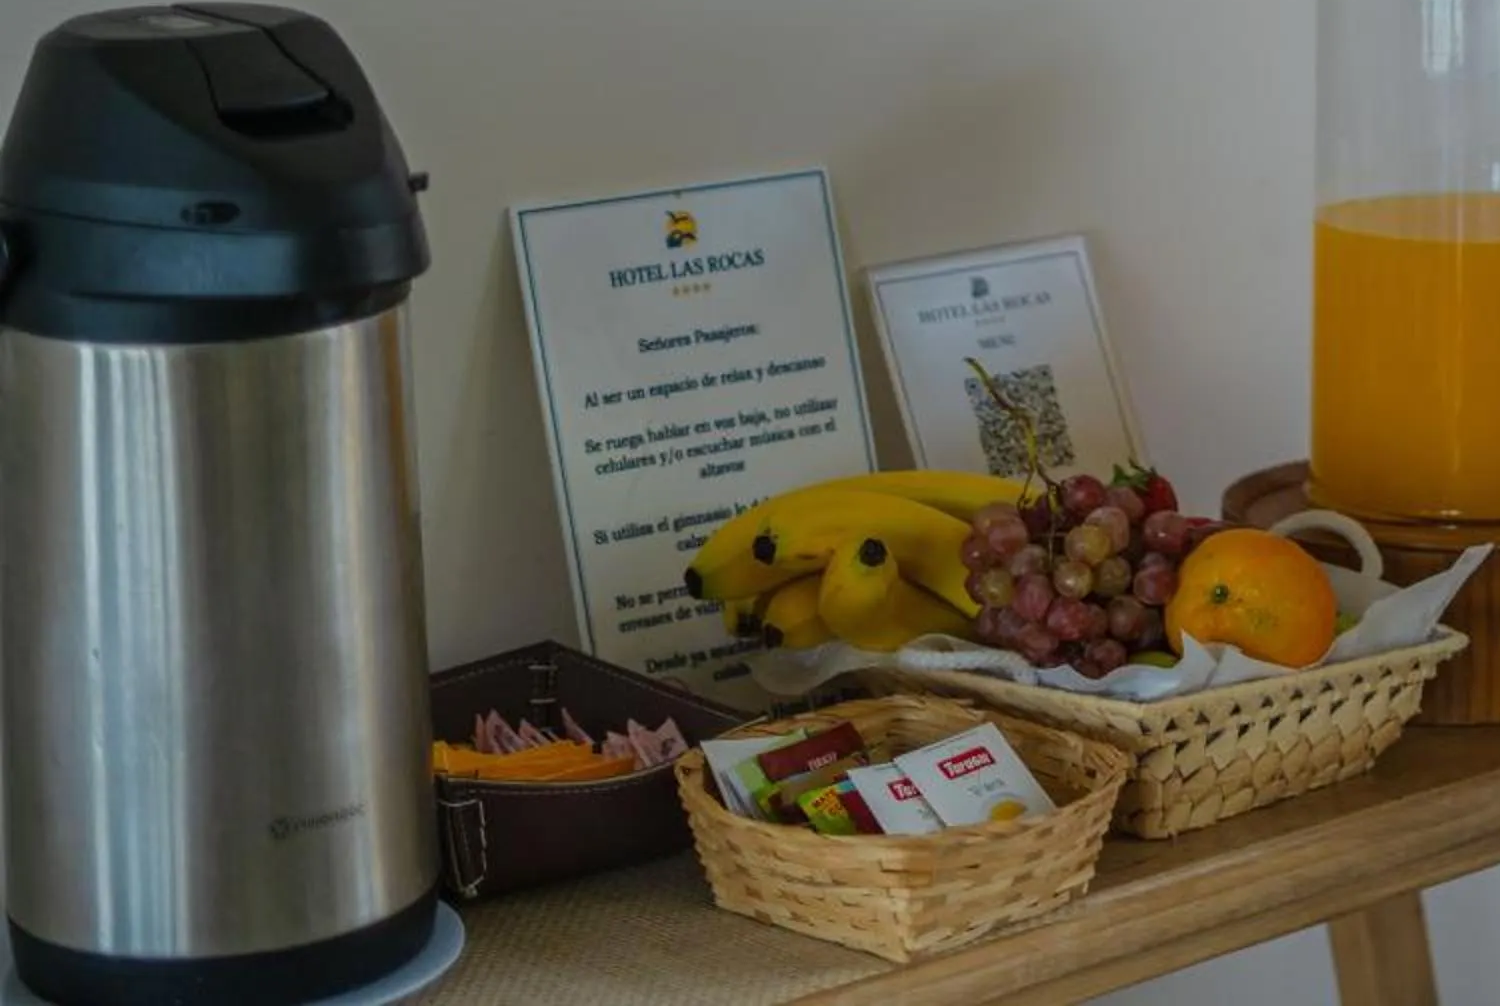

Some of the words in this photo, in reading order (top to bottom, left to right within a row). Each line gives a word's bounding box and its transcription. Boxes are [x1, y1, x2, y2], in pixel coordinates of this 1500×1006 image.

[609, 262, 669, 288] HOTEL
[672, 258, 704, 279] LAS
[708, 248, 766, 273] ROCAS
[917, 303, 968, 324] HOTEL
[971, 298, 1000, 315] LAS
[1002, 291, 1052, 310] ROCAS
[638, 335, 692, 353] Señores
[585, 393, 599, 409] Al
[603, 390, 622, 404] ser
[627, 388, 645, 401] un
[649, 377, 698, 398] espacio
[702, 372, 717, 387] de
[721, 367, 753, 385] relax
[754, 367, 763, 383] y
[767, 356, 826, 376] descanso
[585, 438, 602, 453] Se
[606, 433, 645, 451] ruega
[647, 422, 691, 443] hablar
[694, 421, 711, 434] en
[714, 416, 736, 430] voz
[738, 408, 771, 426] baja,
[774, 406, 791, 419] no
[794, 396, 838, 416] utilizar
[595, 452, 657, 476] celulares
[660, 447, 684, 466] y/o
[687, 435, 745, 458] escuchar
[749, 427, 796, 447] música
[799, 422, 823, 437] con
[825, 416, 837, 433] el
[594, 529, 609, 545] Si
[611, 521, 654, 542] utiliza
[657, 516, 670, 532] el
[673, 506, 733, 533] gimnasio
[615, 594, 635, 610] No
[638, 593, 654, 606] se
[618, 611, 674, 633] envases
[675, 605, 692, 621] de
[645, 650, 687, 674] Desde
[690, 649, 708, 669] ya
